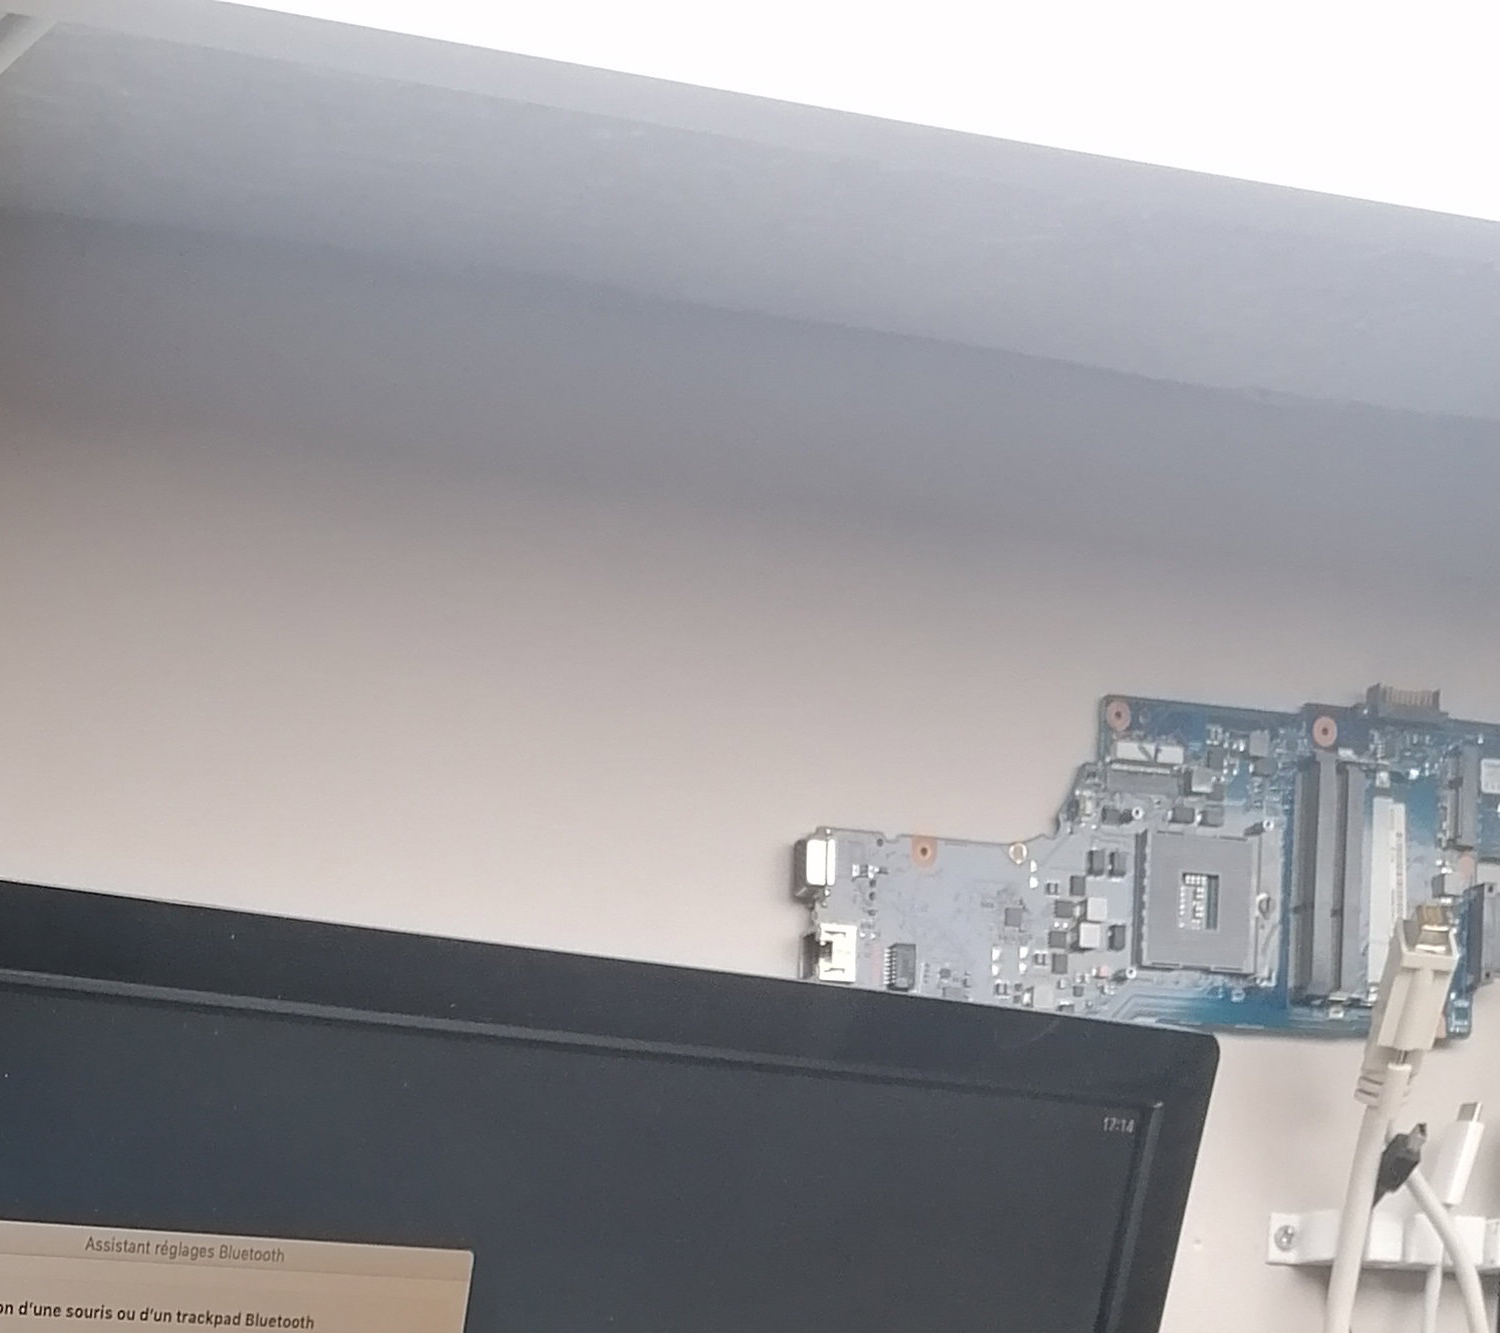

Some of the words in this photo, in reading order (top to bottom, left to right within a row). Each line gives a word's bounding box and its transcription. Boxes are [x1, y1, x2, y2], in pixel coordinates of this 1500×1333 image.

[1103, 1117, 1135, 1133] 17:14
[84, 1236, 151, 1255] Assistant
[154, 1240, 215, 1261] réglages
[218, 1244, 285, 1263] Bluetooth
[65, 1304, 113, 1320] souris
[116, 1309, 136, 1321] ou
[176, 1310, 242, 1328] trackpad
[245, 1312, 315, 1330] Bluetooth
